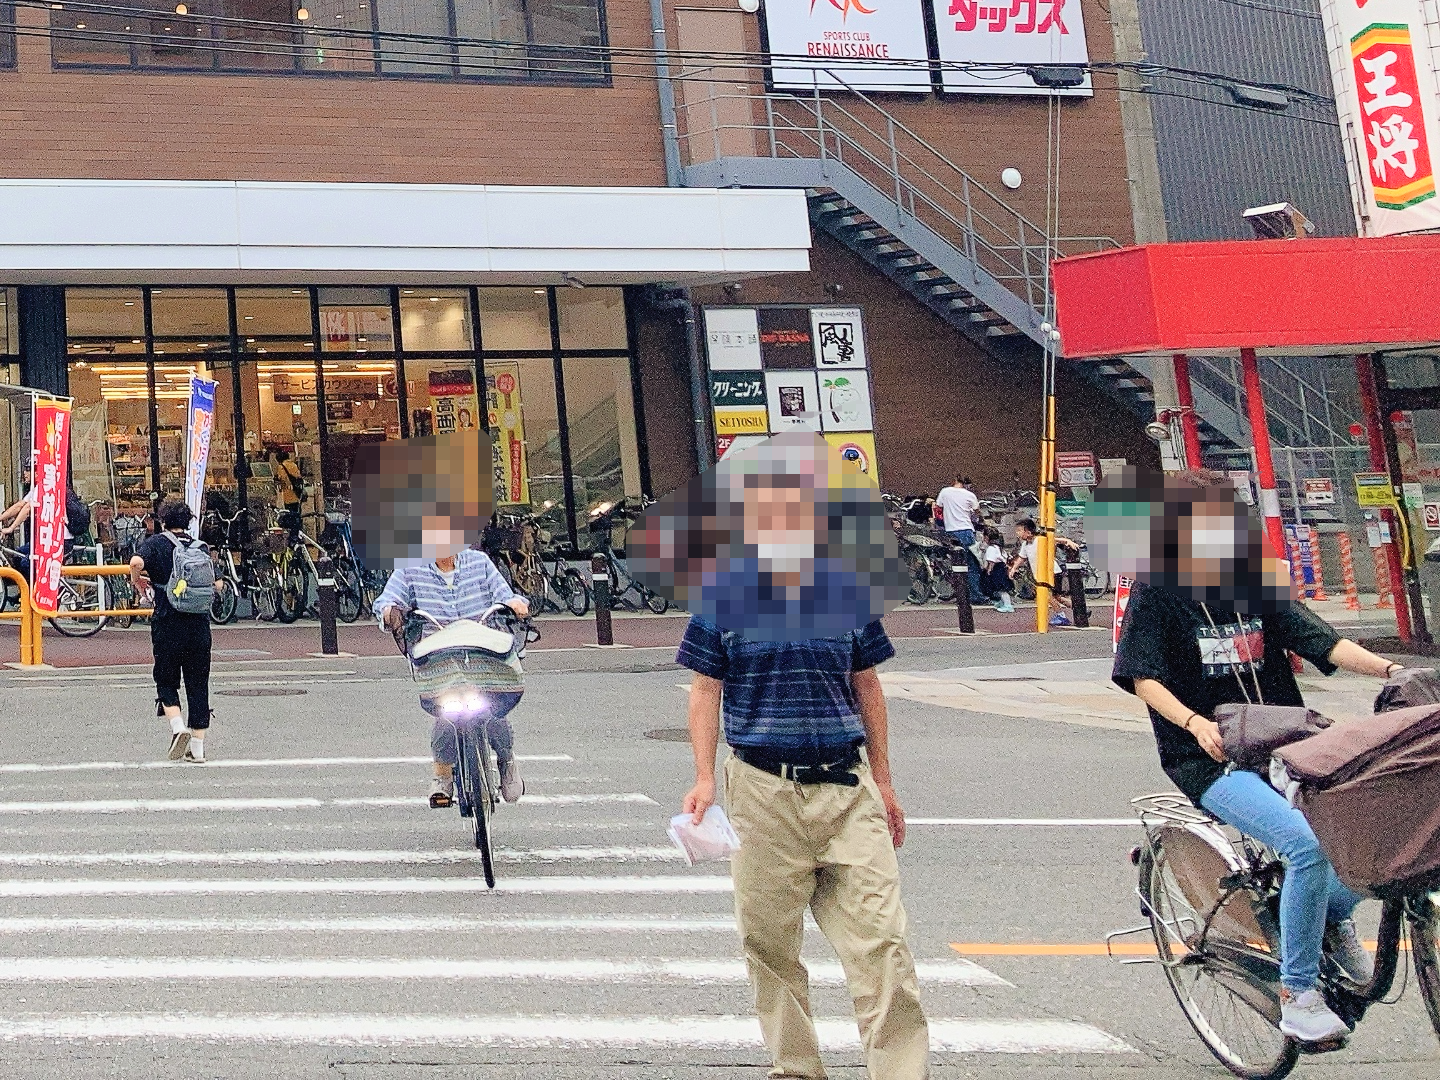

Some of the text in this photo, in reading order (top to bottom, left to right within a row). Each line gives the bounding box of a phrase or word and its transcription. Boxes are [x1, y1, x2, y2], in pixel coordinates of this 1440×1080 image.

[823, 31, 871, 41] SPORTS CLUB
[807, 42, 889, 58] RENAISSANCE
[1360, 50, 1419, 183] 王将
[719, 416, 764, 428] SEIYOSHA
[718, 438, 731, 449] 2F
[1199, 620, 1263, 637] TOMMY
